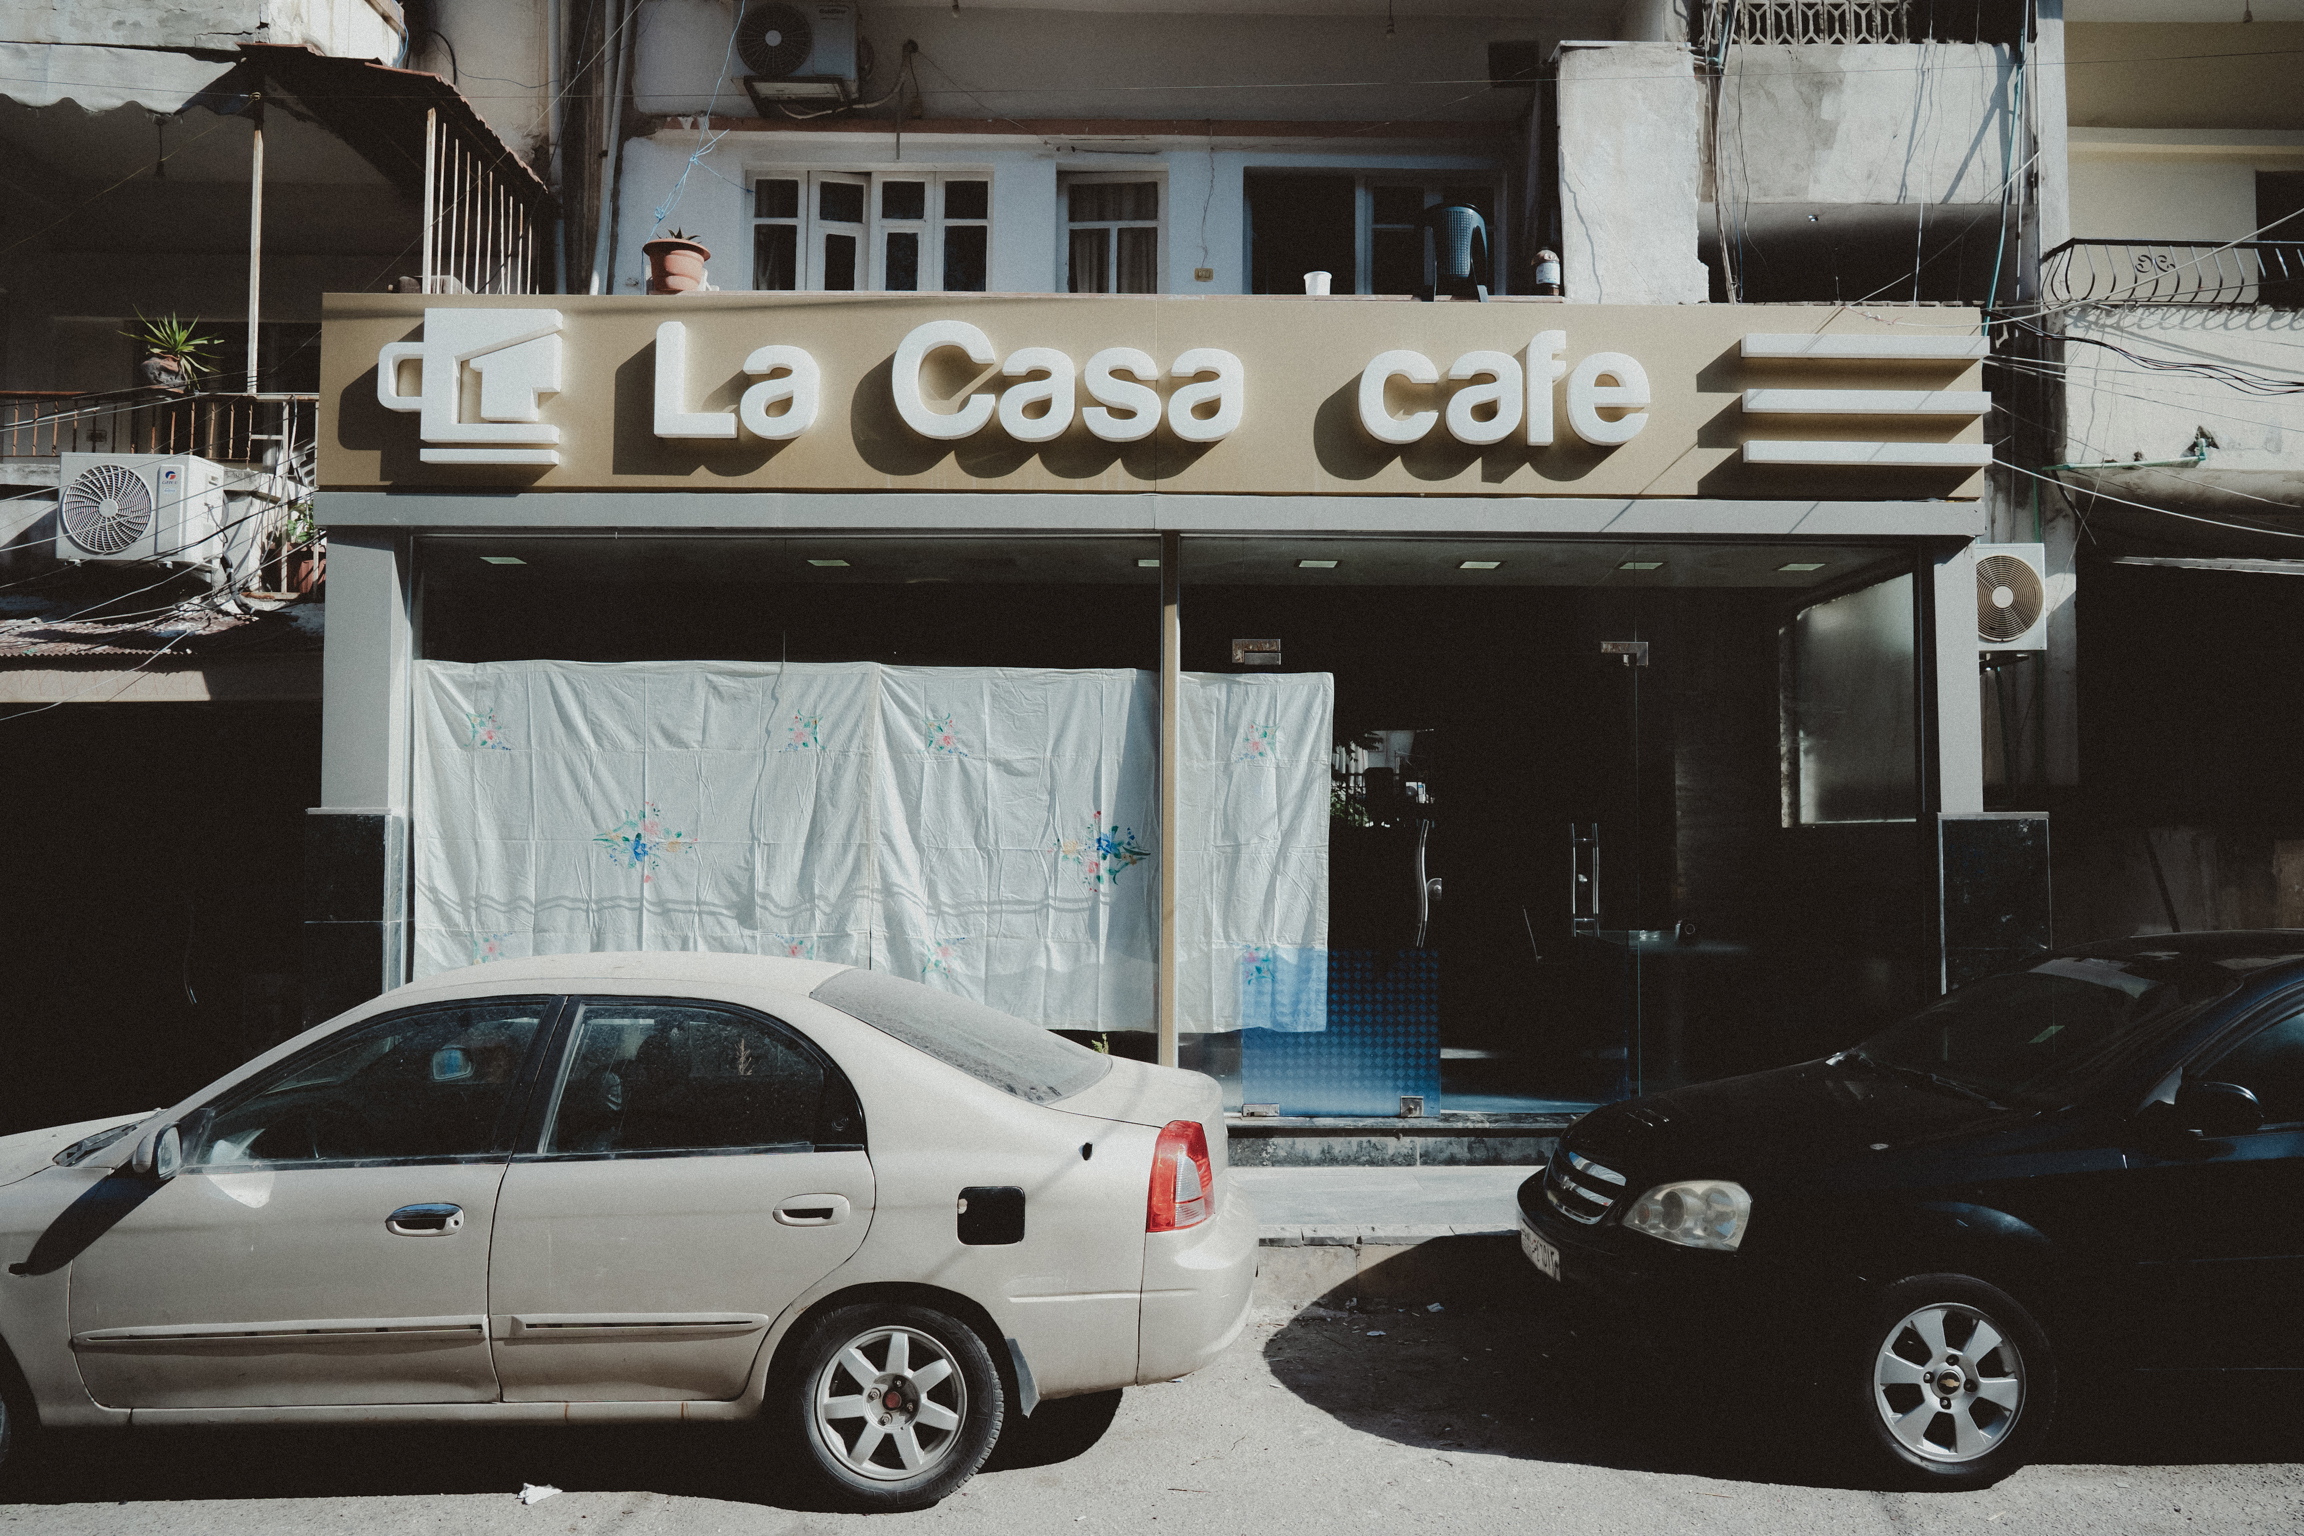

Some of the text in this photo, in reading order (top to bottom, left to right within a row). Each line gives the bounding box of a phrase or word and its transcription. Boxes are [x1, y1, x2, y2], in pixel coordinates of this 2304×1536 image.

[654, 320, 1651, 446] La Casa cafe
